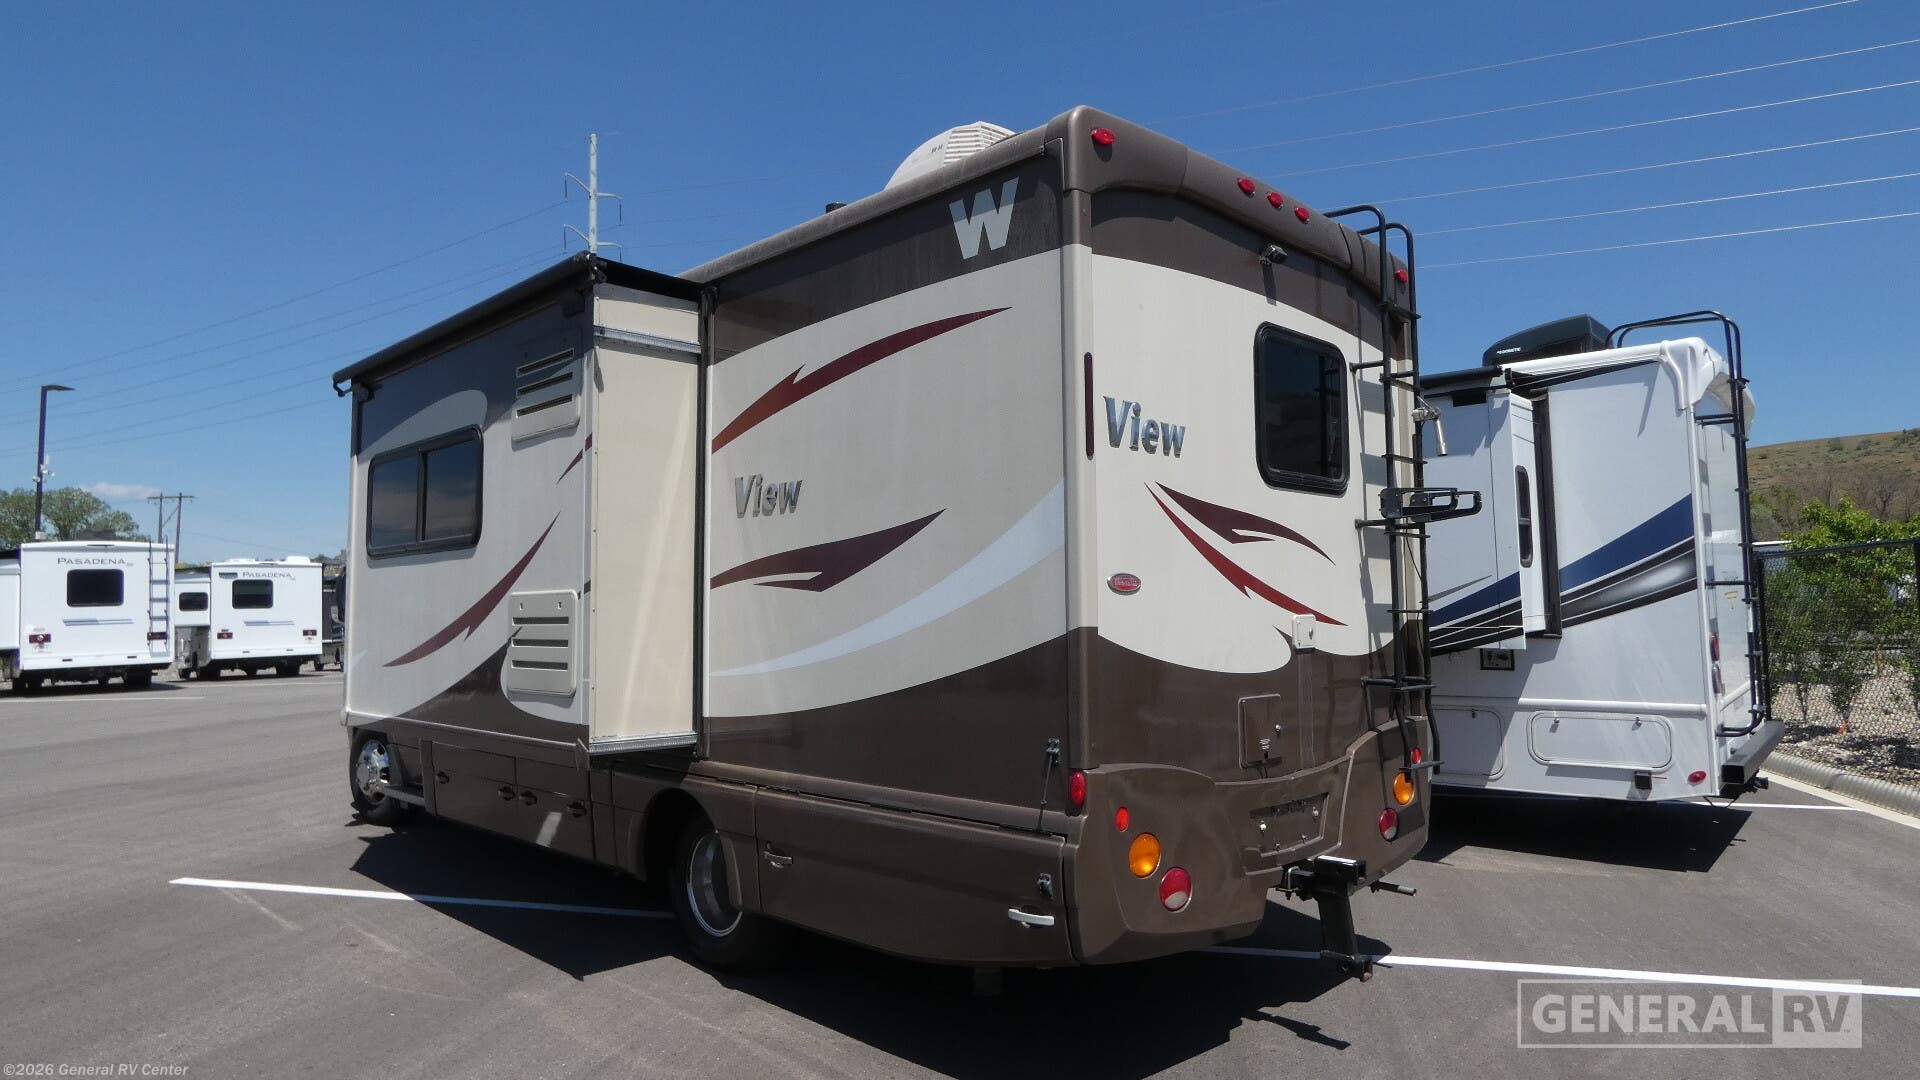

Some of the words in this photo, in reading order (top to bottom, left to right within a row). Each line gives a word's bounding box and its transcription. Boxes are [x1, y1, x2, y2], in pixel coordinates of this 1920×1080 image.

[948, 176, 1020, 260] W
[1102, 395, 1186, 459] View
[734, 473, 803, 519] View
[57, 557, 126, 565] PASADENA
